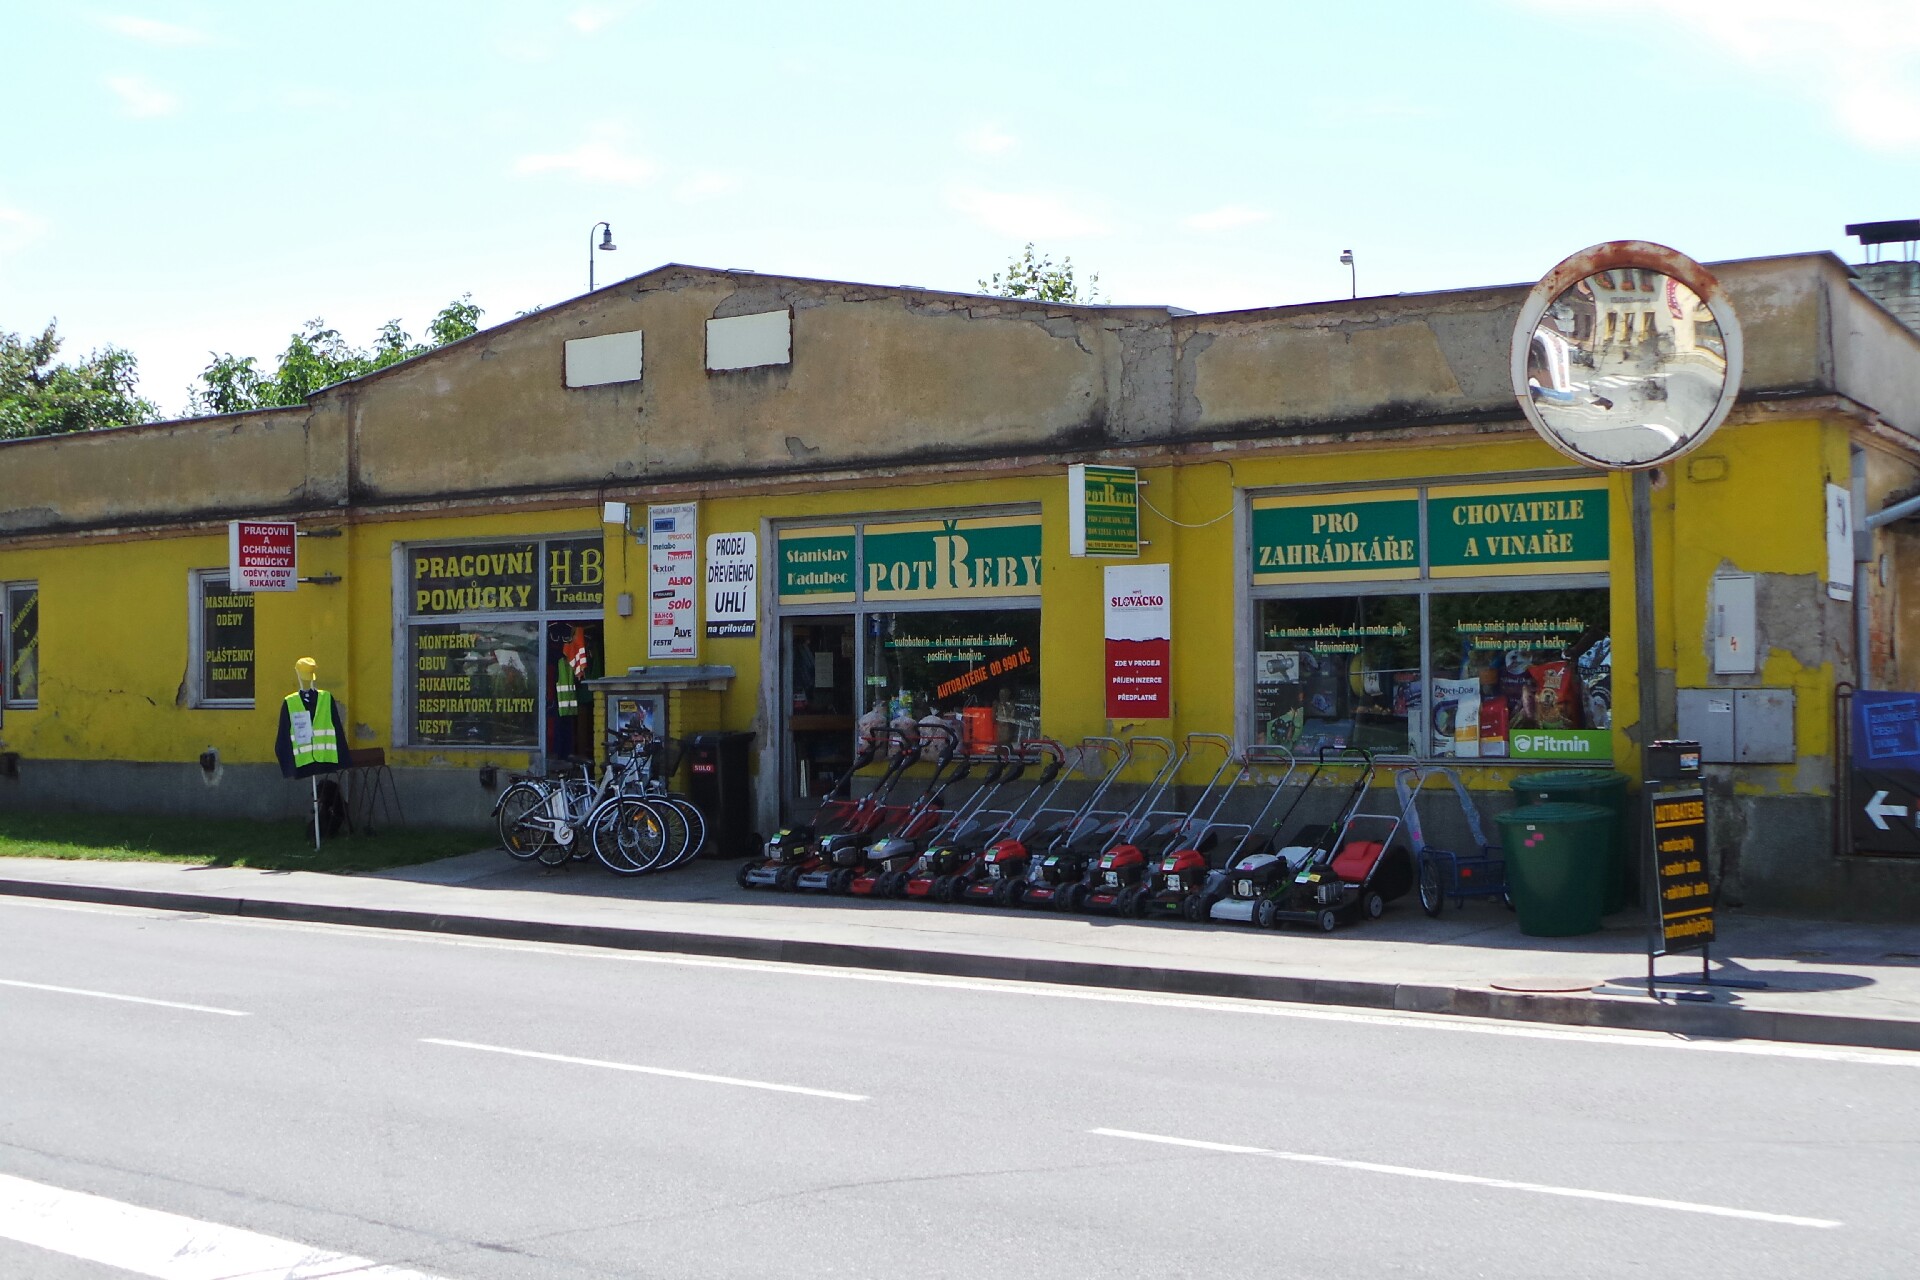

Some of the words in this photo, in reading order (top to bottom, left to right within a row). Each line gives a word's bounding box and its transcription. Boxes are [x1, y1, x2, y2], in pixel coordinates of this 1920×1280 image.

[1452, 500, 1584, 526] CHOVATELE
[1312, 512, 1358, 534] PRO
[244, 526, 289, 536] PRACOVNÍ
[263, 536, 270, 544] A
[716, 537, 746, 556] PRODEJ
[1464, 538, 1479, 558] A
[1486, 529, 1573, 556] VINAŘE
[242, 544, 292, 554] OCHRANNÉ
[786, 548, 849, 563] Stanislav
[868, 520, 1041, 592] POTŘEBY
[1259, 536, 1414, 566] ZAHRÁDKÁŘE
[244, 554, 289, 566] POMŮCKY
[414, 545, 533, 578] PRACOVNÍ
[243, 568, 269, 579] ODĚVY,
[270, 570, 290, 578] OBUV
[708, 560, 754, 583] DŘEVĚNÉHO
[787, 572, 849, 586] Kadubec
[250, 579, 286, 587] RUKAVICE
[668, 576, 692, 586] AL-KO
[416, 580, 532, 611] POMŮCKY
[555, 588, 604, 604] Trading
[714, 585, 748, 612] UHLÍ
[1111, 595, 1164, 608] SLOVÁCKO
[668, 598, 692, 610] solo
[216, 611, 243, 626] ODĚVY
[718, 623, 754, 635] grilování
[1270, 625, 1279, 637] el.
[1280, 629, 1286, 637] a
[1287, 627, 1310, 637] motor.
[1312, 624, 1341, 638] sekačky
[1348, 622, 1357, 636] el.
[1366, 626, 1390, 635] motor.
[1458, 620, 1482, 632] krmné
[1484, 620, 1504, 632] směsi
[1506, 622, 1520, 634] pro
[1550, 622, 1554, 631] a
[894, 634, 930, 647] autobaterie
[1504, 640, 1517, 651] pro
[1518, 640, 1531, 651] psy
[1536, 640, 1541, 648] a
[206, 646, 254, 662] PLÁŠTĚNKY
[212, 665, 248, 680] HOLÍNKY
[990, 661, 1001, 676] OD
[1002, 657, 1018, 672] 990
[1112, 676, 1134, 684] PŘÍJEM
[496, 698, 534, 713] FILTRY
[1534, 736, 1590, 752] Fitmin
